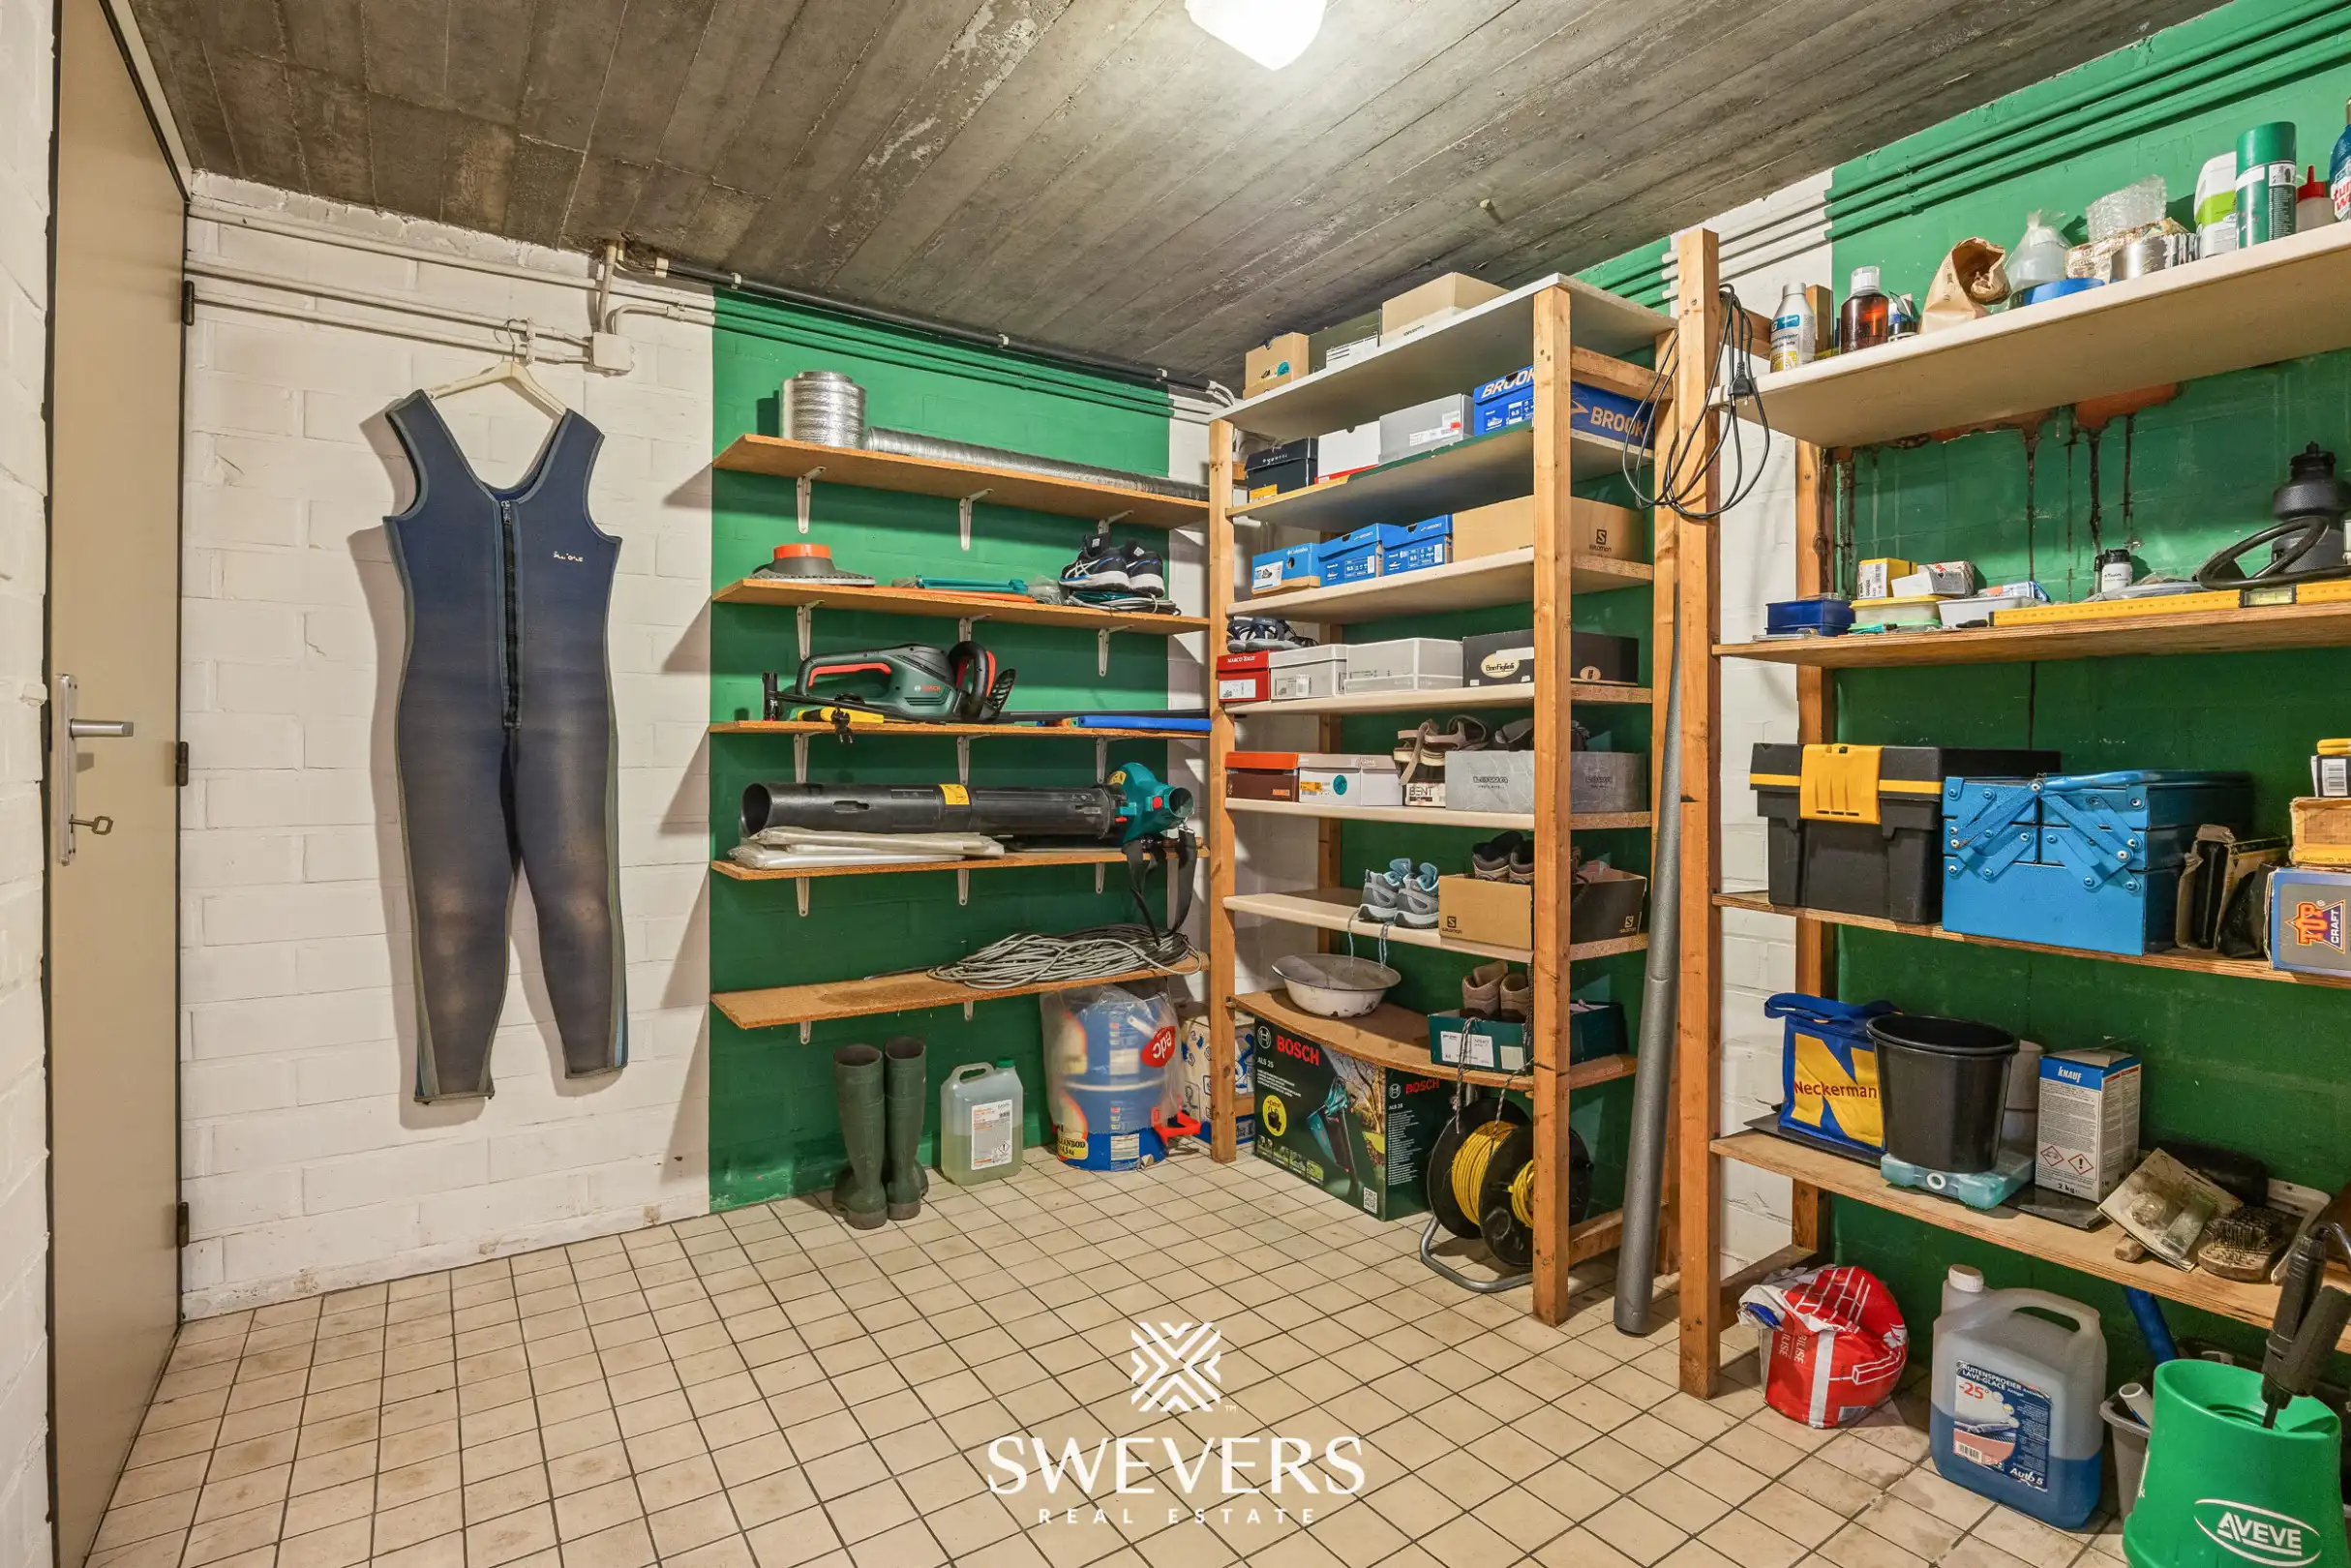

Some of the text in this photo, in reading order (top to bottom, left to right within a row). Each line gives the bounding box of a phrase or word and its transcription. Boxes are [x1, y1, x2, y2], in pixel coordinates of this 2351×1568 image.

[2331, 909, 2340, 944] CRAFT
[1277, 1035, 1320, 1067] BOSCH
[1405, 1078, 1440, 1095] BOSCH
[1961, 1363, 2022, 1391] RUITENSPROEIER
[1962, 1369, 2006, 1390] LAVE-GLACE
[2010, 1467, 2044, 1486] Auto 5
[2216, 1511, 2303, 1551] AVEVE
